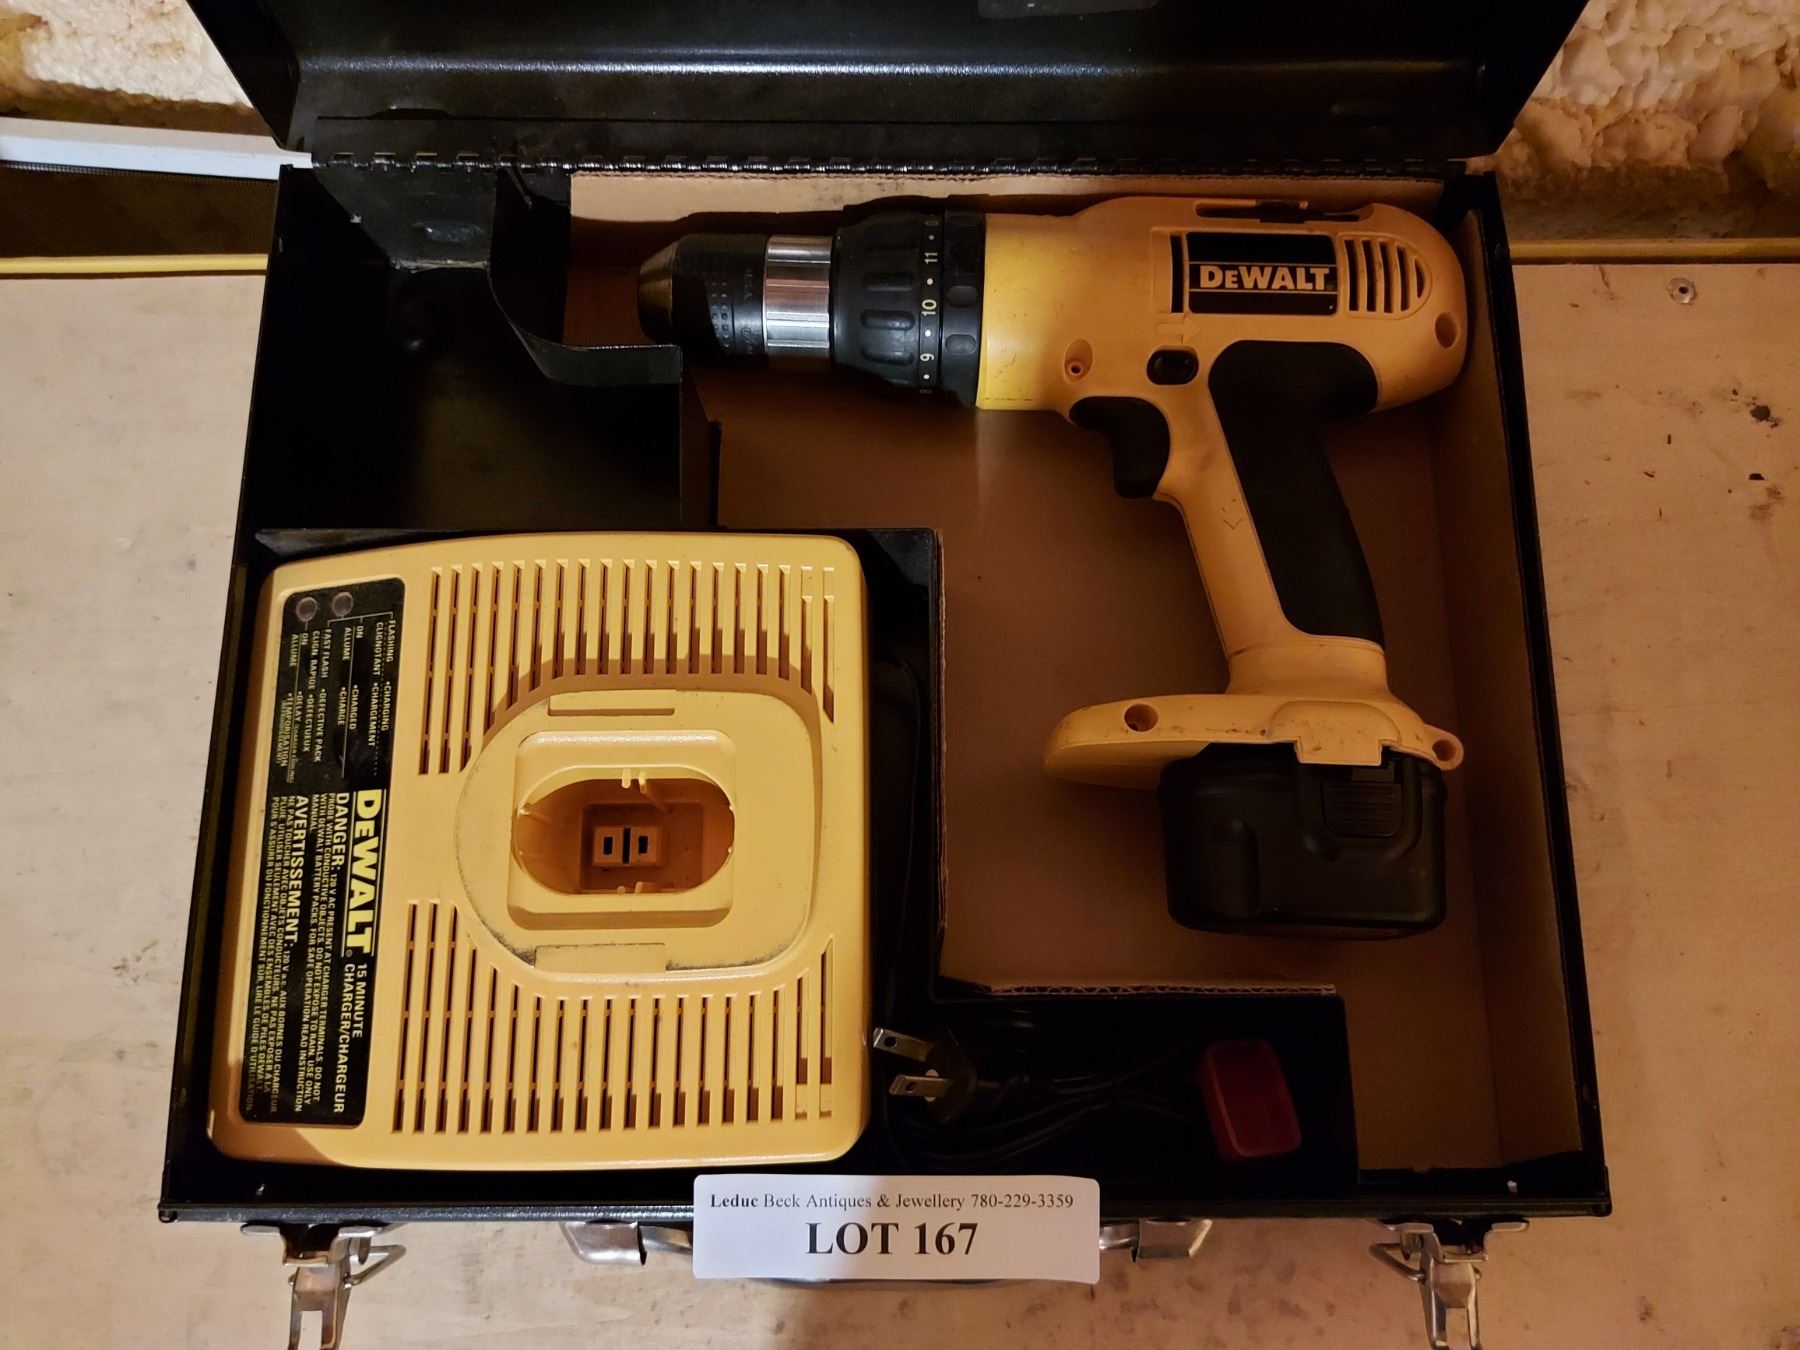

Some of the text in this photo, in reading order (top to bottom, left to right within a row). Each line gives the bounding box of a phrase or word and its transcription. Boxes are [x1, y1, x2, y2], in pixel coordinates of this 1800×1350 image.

[924, 253, 939, 265] 11
[921, 299, 937, 317] 10
[919, 353, 935, 362] 9
[354, 624, 364, 639] ON
[385, 619, 397, 663] FLASHING
[320, 628, 333, 678] FAST FLASH
[371, 621, 384, 676] CLIGNOTANT
[306, 658, 318, 690] RAPIDE
[313, 737, 323, 762] PACK
[269, 796, 280, 820] POUR
[287, 795, 295, 807] NE
[318, 792, 328, 816] WITH
[325, 792, 336, 821] PROBE
[285, 808, 295, 826] PAS
[274, 822, 285, 860] UTILISER
[314, 818, 326, 853] DEWALT
[323, 822, 334, 845] WITH
[329, 791, 350, 870] DANGER:
[281, 828, 293, 867] TOUCHER
[264, 868, 274, 881] DU
[279, 868, 289, 891] AVEC
[281, 794, 310, 948] AVERTISSEMENT:
[311, 854, 323, 893] BATTERY
[319, 846, 332, 902] CONDUCTIVE
[329, 873, 337, 887] 120
[269, 861, 282, 913] SEULEMENT
[276, 892, 287, 926] OBJETS
[327, 896, 336, 909] AC
[257, 882, 273, 962] FONCTIONNEMENT
[268, 914, 277, 937] AVEC
[323, 910, 335, 950] PRESENT
[266, 938, 275, 956] DES
[307, 927, 317, 945] FOR
[282, 949, 290, 964] 120
[305, 946, 316, 969] SAFE
[314, 946, 324, 960] DO
[323, 951, 332, 963] AT
[313, 961, 323, 981] NOT
[254, 984, 263, 1003] LIRE
[261, 957, 274, 1011] ENSEMBLES
[301, 970, 314, 1022] OPERATION
[319, 964, 331, 1008] CHARGER
[253, 1005, 261, 1016] LE
[270, 995, 278, 1008] NE
[278, 989, 287, 1009] AUX
[310, 981, 321, 1017] EXPOSE
[351, 962, 368, 1038] 15 MINUTE
[260, 1012, 269, 1024] DE
[268, 1009, 277, 1029] PAS
[275, 1010, 286, 1047] BORNES
[309, 1018, 318, 1031] TO
[250, 1017, 260, 1045] GUIDE
[258, 1025, 268, 1051] PILES
[299, 1023, 310, 1048] READ
[331, 962, 356, 1113] CHARGER/CHARGEUR
[264, 1030, 275, 1071] EXPOSER
[273, 1048, 282, 1062] DU
[293, 1049, 308, 1112] INSTRUCTION
[305, 1059, 315, 1078] USE
[314, 1065, 323, 1080] DO
[303, 1079, 313, 1105] ONLY
[311, 1081, 322, 1102] NOT
[710, 1193, 1074, 1212] Leduc Beck Antiques & Jewellery 780-229-3359
[805, 1222, 978, 1255] LOT 167
